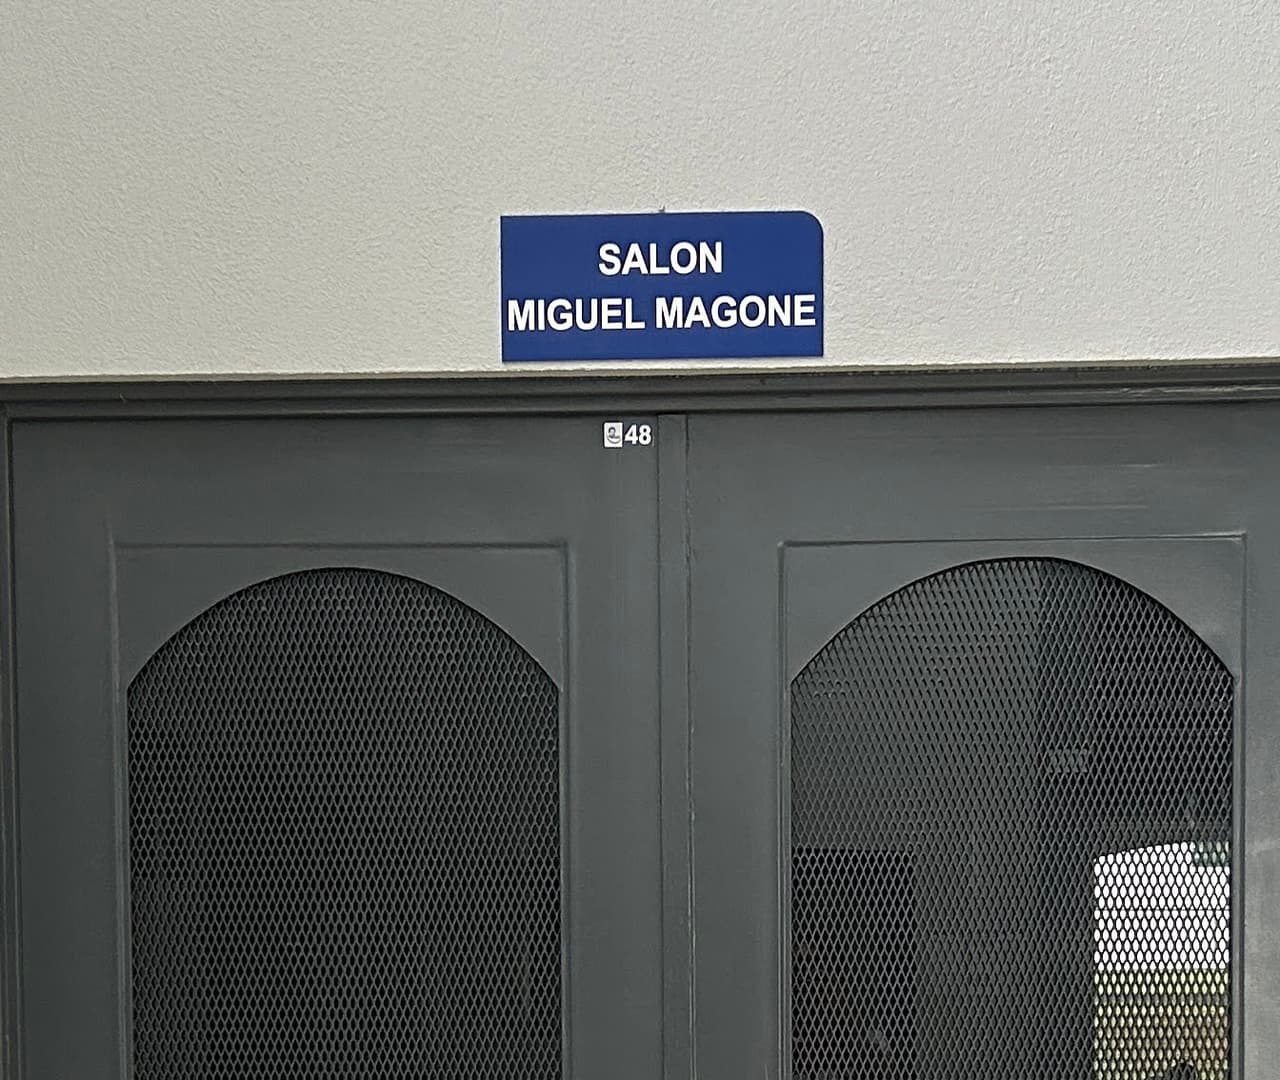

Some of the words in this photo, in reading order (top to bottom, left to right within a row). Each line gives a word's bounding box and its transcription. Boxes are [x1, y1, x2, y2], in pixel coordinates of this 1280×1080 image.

[598, 241, 722, 276] SALON
[507, 298, 646, 331] MIGUEL
[655, 294, 816, 329] MAGONE
[624, 424, 652, 446] 48
